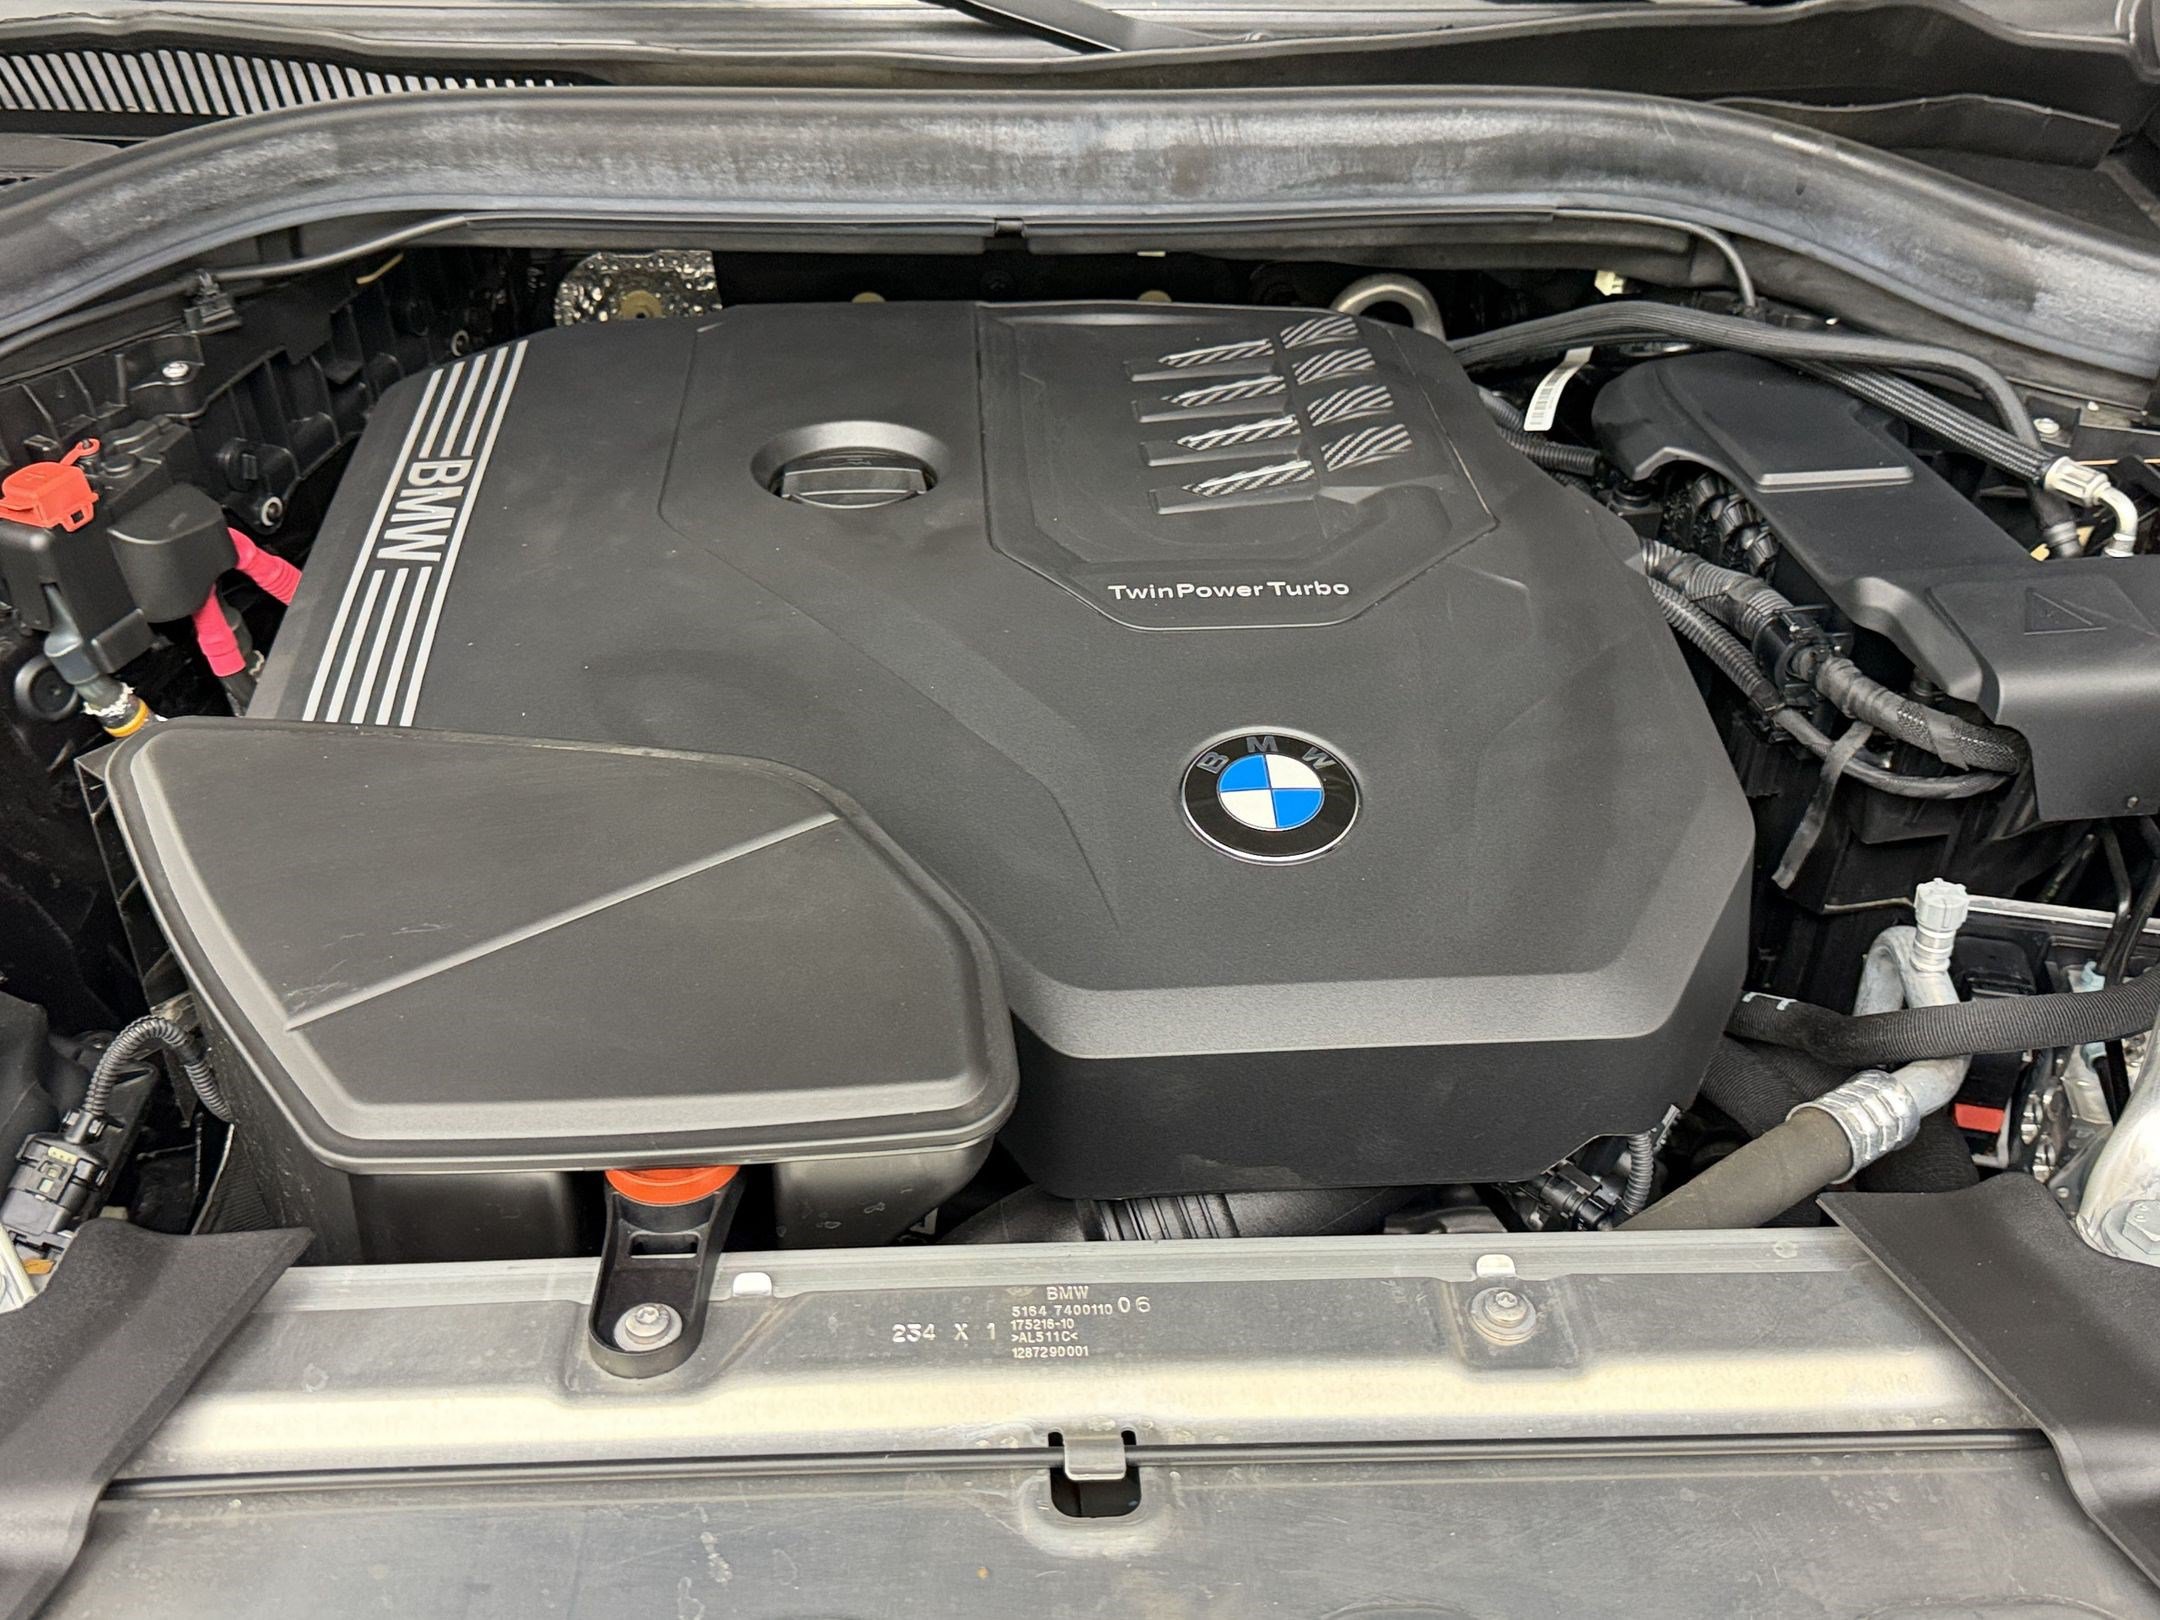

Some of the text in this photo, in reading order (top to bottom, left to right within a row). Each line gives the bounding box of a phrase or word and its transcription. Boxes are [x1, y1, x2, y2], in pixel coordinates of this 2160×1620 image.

[377, 459, 474, 562] BMW
[1196, 735, 1337, 774] BMW
[1046, 1286, 1089, 1301] BMW
[1011, 1304, 1048, 1317] 5164
[1054, 1303, 1113, 1317] 7400110
[1010, 1318, 1075, 1331] 175216-10
[1011, 1345, 1089, 1360] 1287290001
